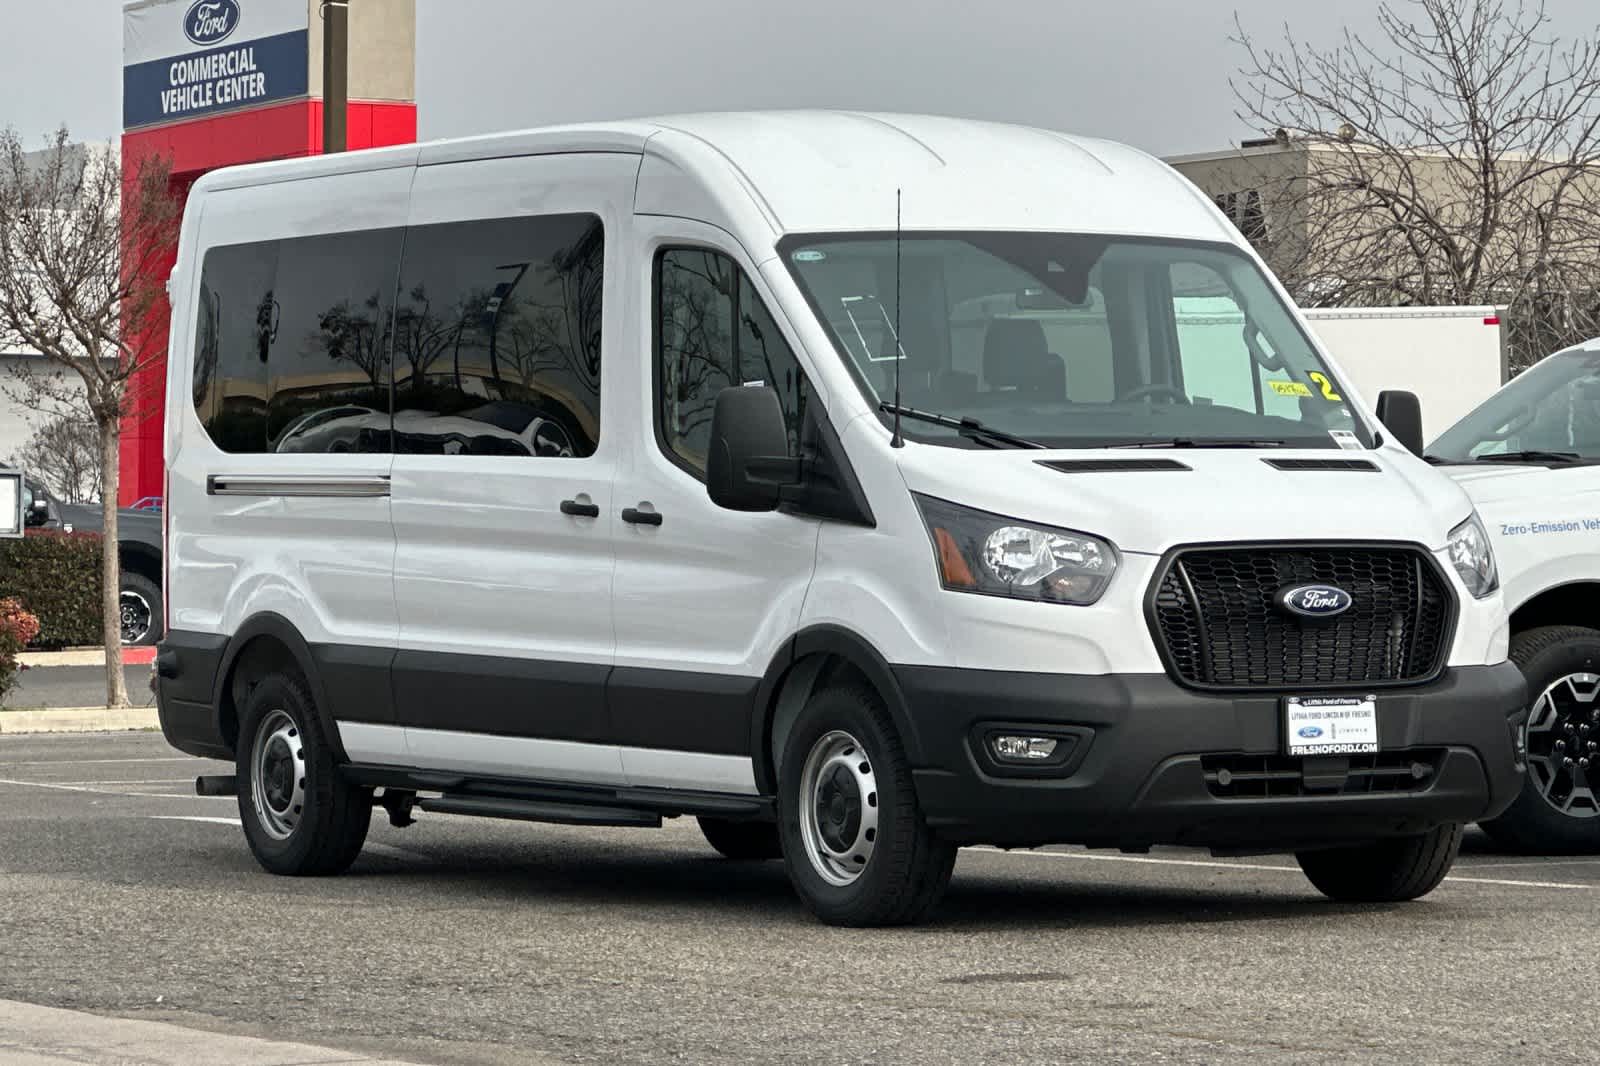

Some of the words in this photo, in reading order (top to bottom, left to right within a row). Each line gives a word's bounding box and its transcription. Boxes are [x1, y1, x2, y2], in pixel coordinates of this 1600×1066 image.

[194, 3, 229, 38] Ford
[169, 47, 257, 87] COMMERCIAL
[161, 82, 213, 114] VEHICLE
[215, 71, 266, 104] CENTER
[1309, 371, 1343, 401] 2
[1500, 522, 1580, 536] Zero-Emission
[1302, 590, 1339, 609] Ford
